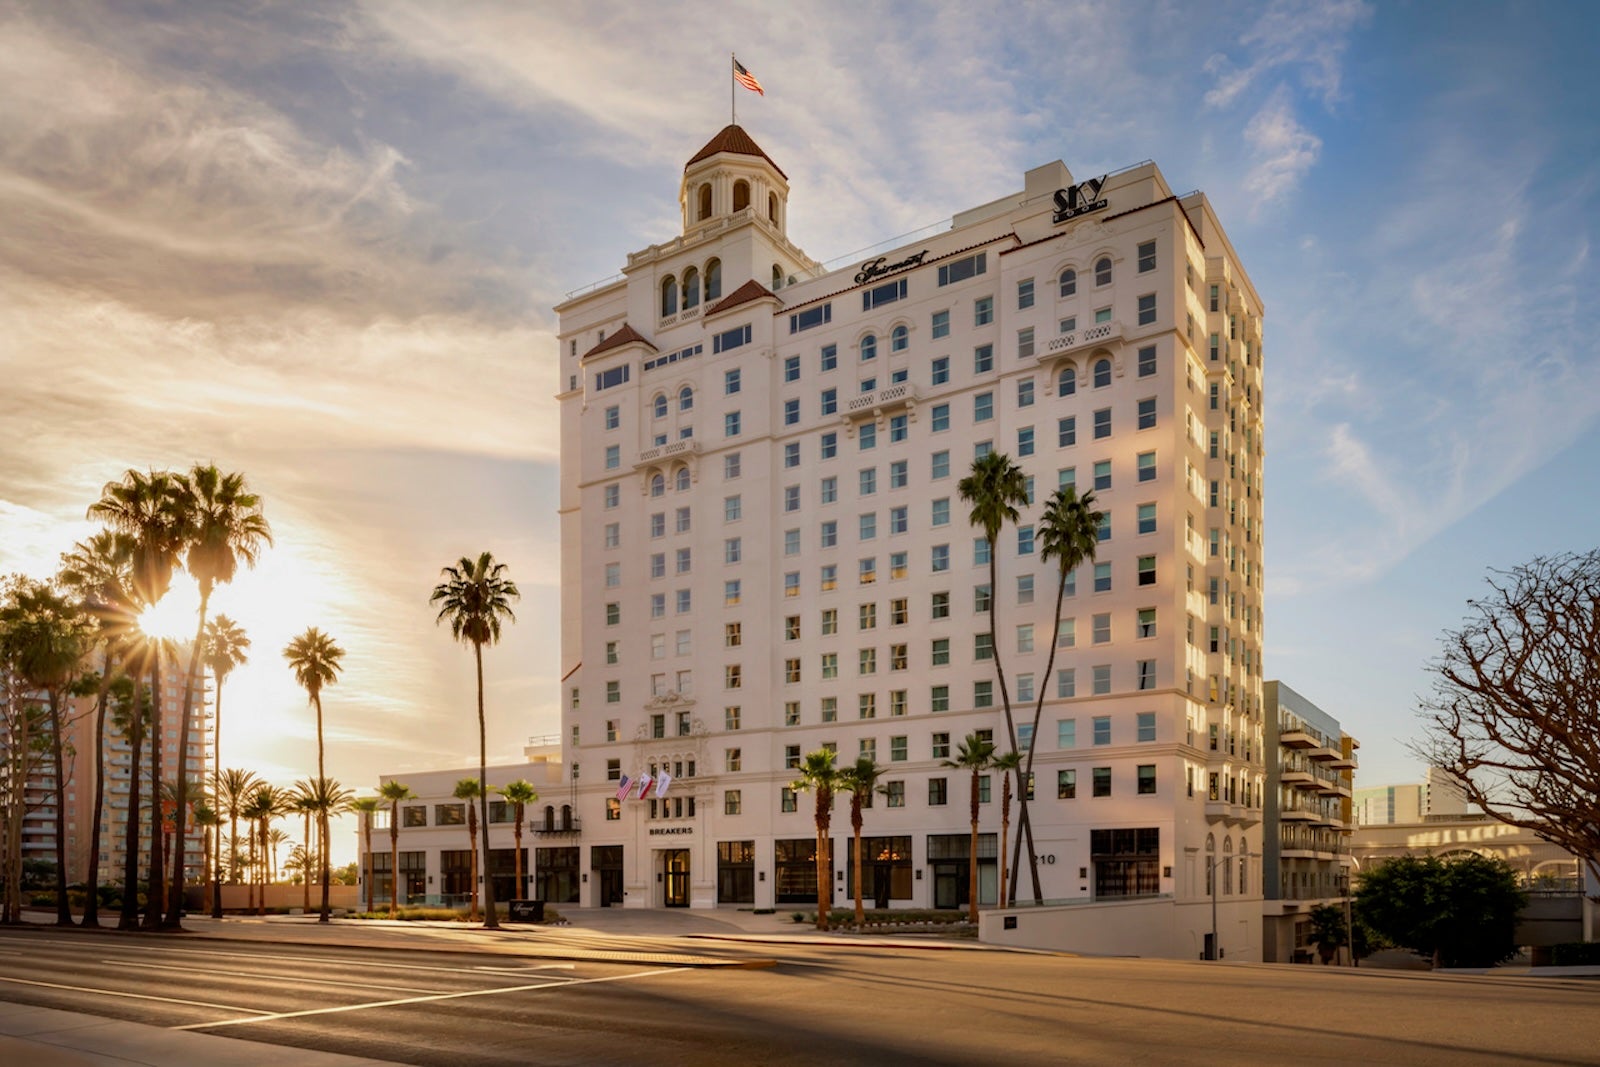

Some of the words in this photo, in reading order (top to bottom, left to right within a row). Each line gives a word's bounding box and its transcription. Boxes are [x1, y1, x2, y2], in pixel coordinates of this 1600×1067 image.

[1053, 174, 1107, 214] SKY
[854, 249, 930, 284] Fairmont
[649, 827, 693, 836] BREAKERS
